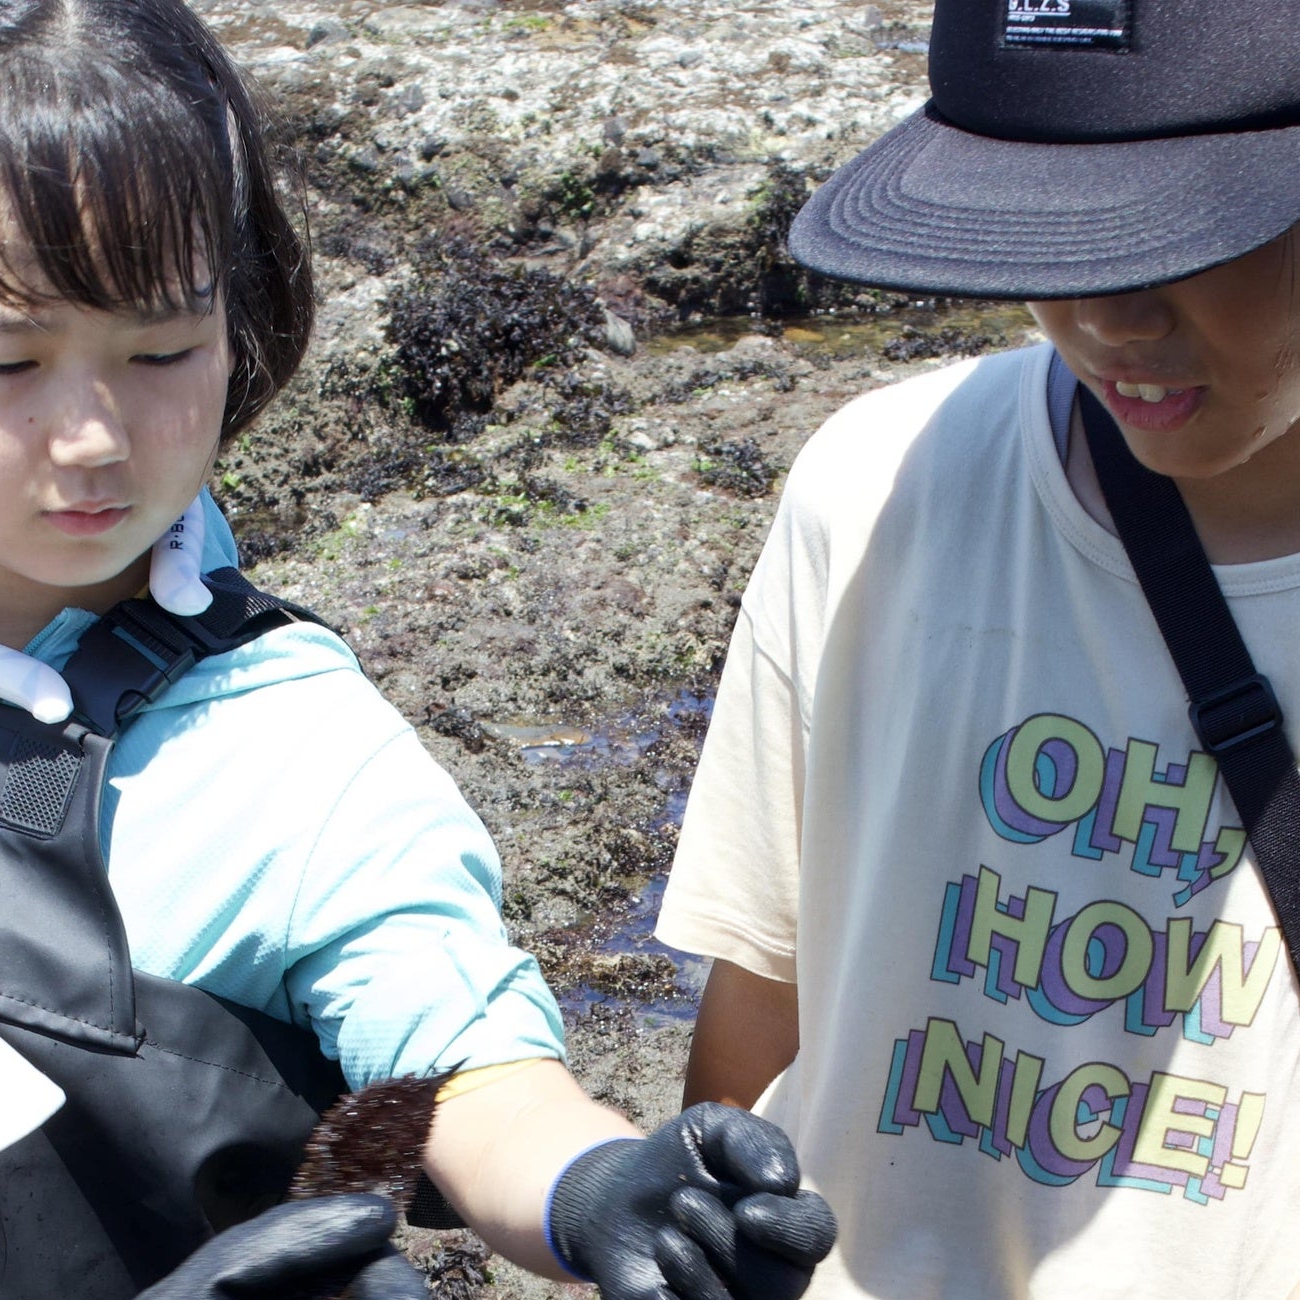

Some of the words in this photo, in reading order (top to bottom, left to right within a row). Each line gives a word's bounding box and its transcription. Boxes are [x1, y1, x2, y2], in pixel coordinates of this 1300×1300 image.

[979, 712, 1248, 908] OH,
[930, 864, 1283, 1046] HOW
[877, 1016, 1267, 1206] NICE!
